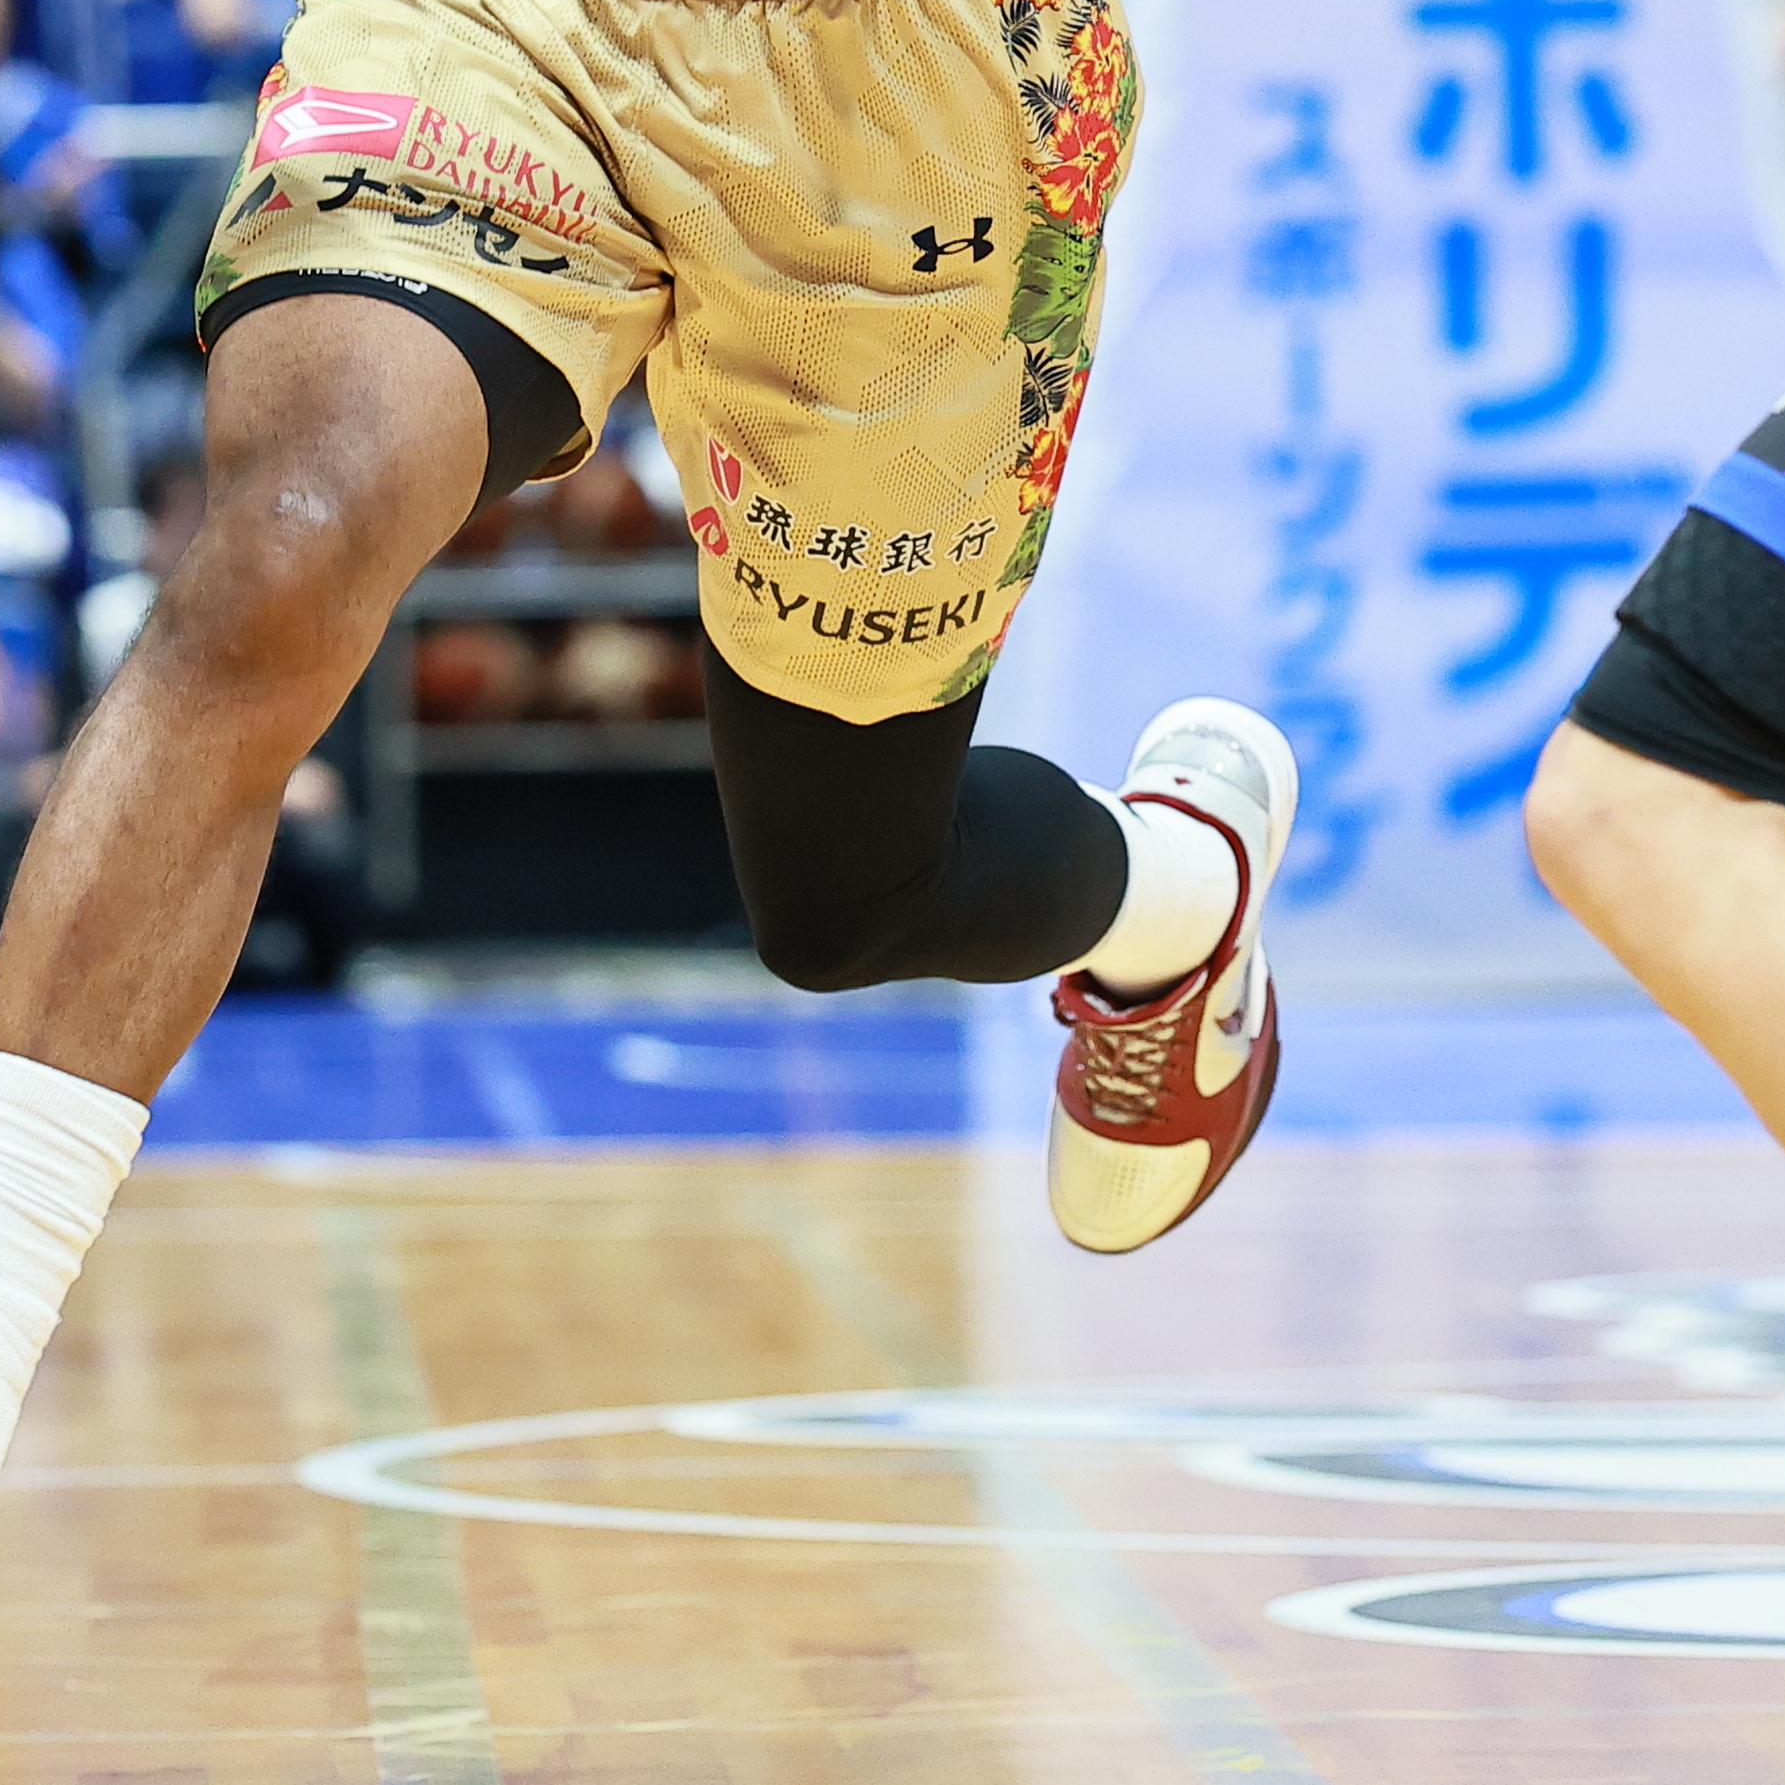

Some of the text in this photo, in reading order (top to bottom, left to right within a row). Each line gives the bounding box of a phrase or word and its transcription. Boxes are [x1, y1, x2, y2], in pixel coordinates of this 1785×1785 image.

[744, 492, 996, 574] 琉球銀行
[734, 558, 985, 645] RYUSEKI
